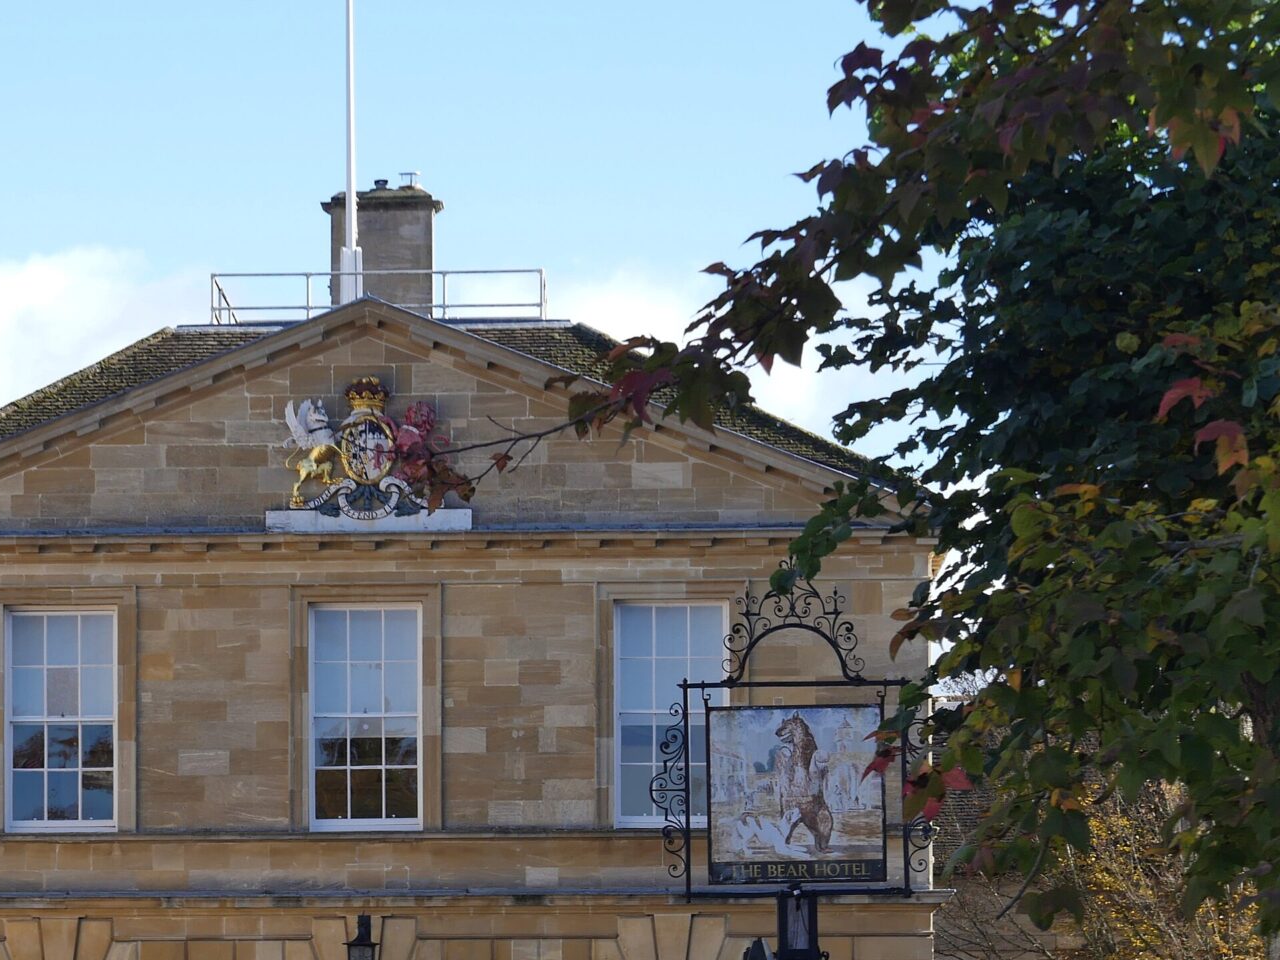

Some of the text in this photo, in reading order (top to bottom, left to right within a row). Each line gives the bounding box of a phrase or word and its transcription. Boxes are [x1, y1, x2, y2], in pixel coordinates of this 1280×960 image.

[730, 862, 870, 879] THE BEAR HOTEL
